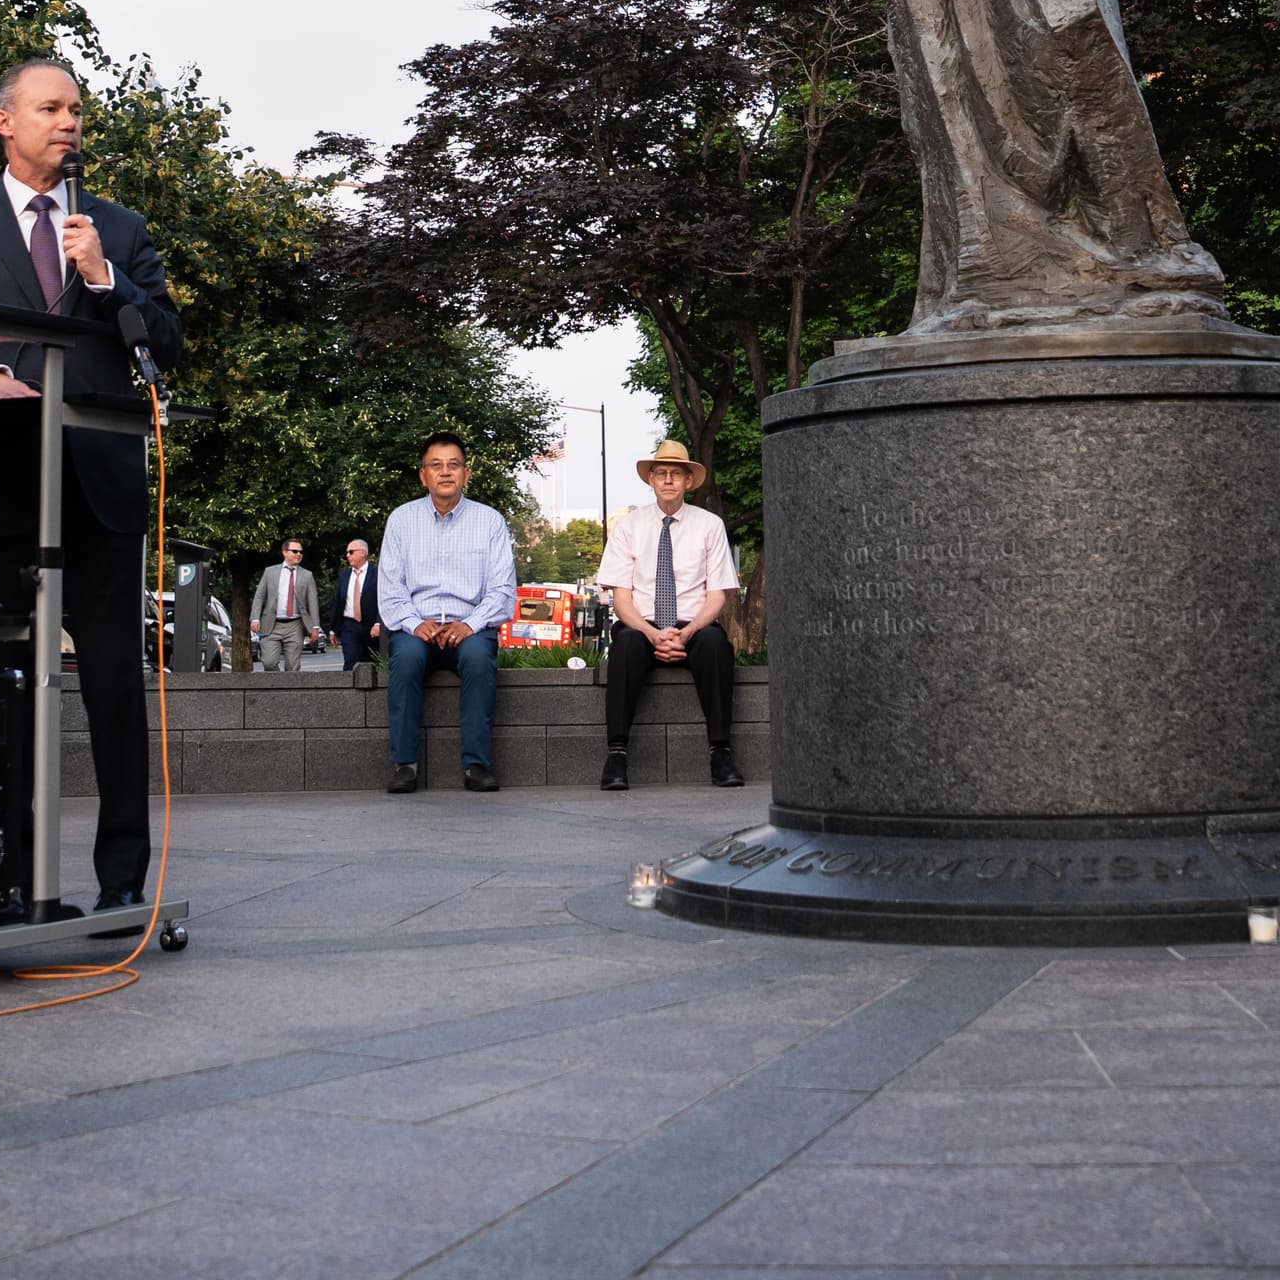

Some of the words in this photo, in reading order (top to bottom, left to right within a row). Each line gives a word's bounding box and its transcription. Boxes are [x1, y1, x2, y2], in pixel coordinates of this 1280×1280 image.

[897, 499, 944, 526] the
[843, 545, 885, 565] one
[896, 536, 1017, 563] hundred
[181, 566, 191, 583] P
[842, 614, 865, 636] to
[873, 608, 942, 636] those
[786, 850, 1211, 882] COMMUNISM
